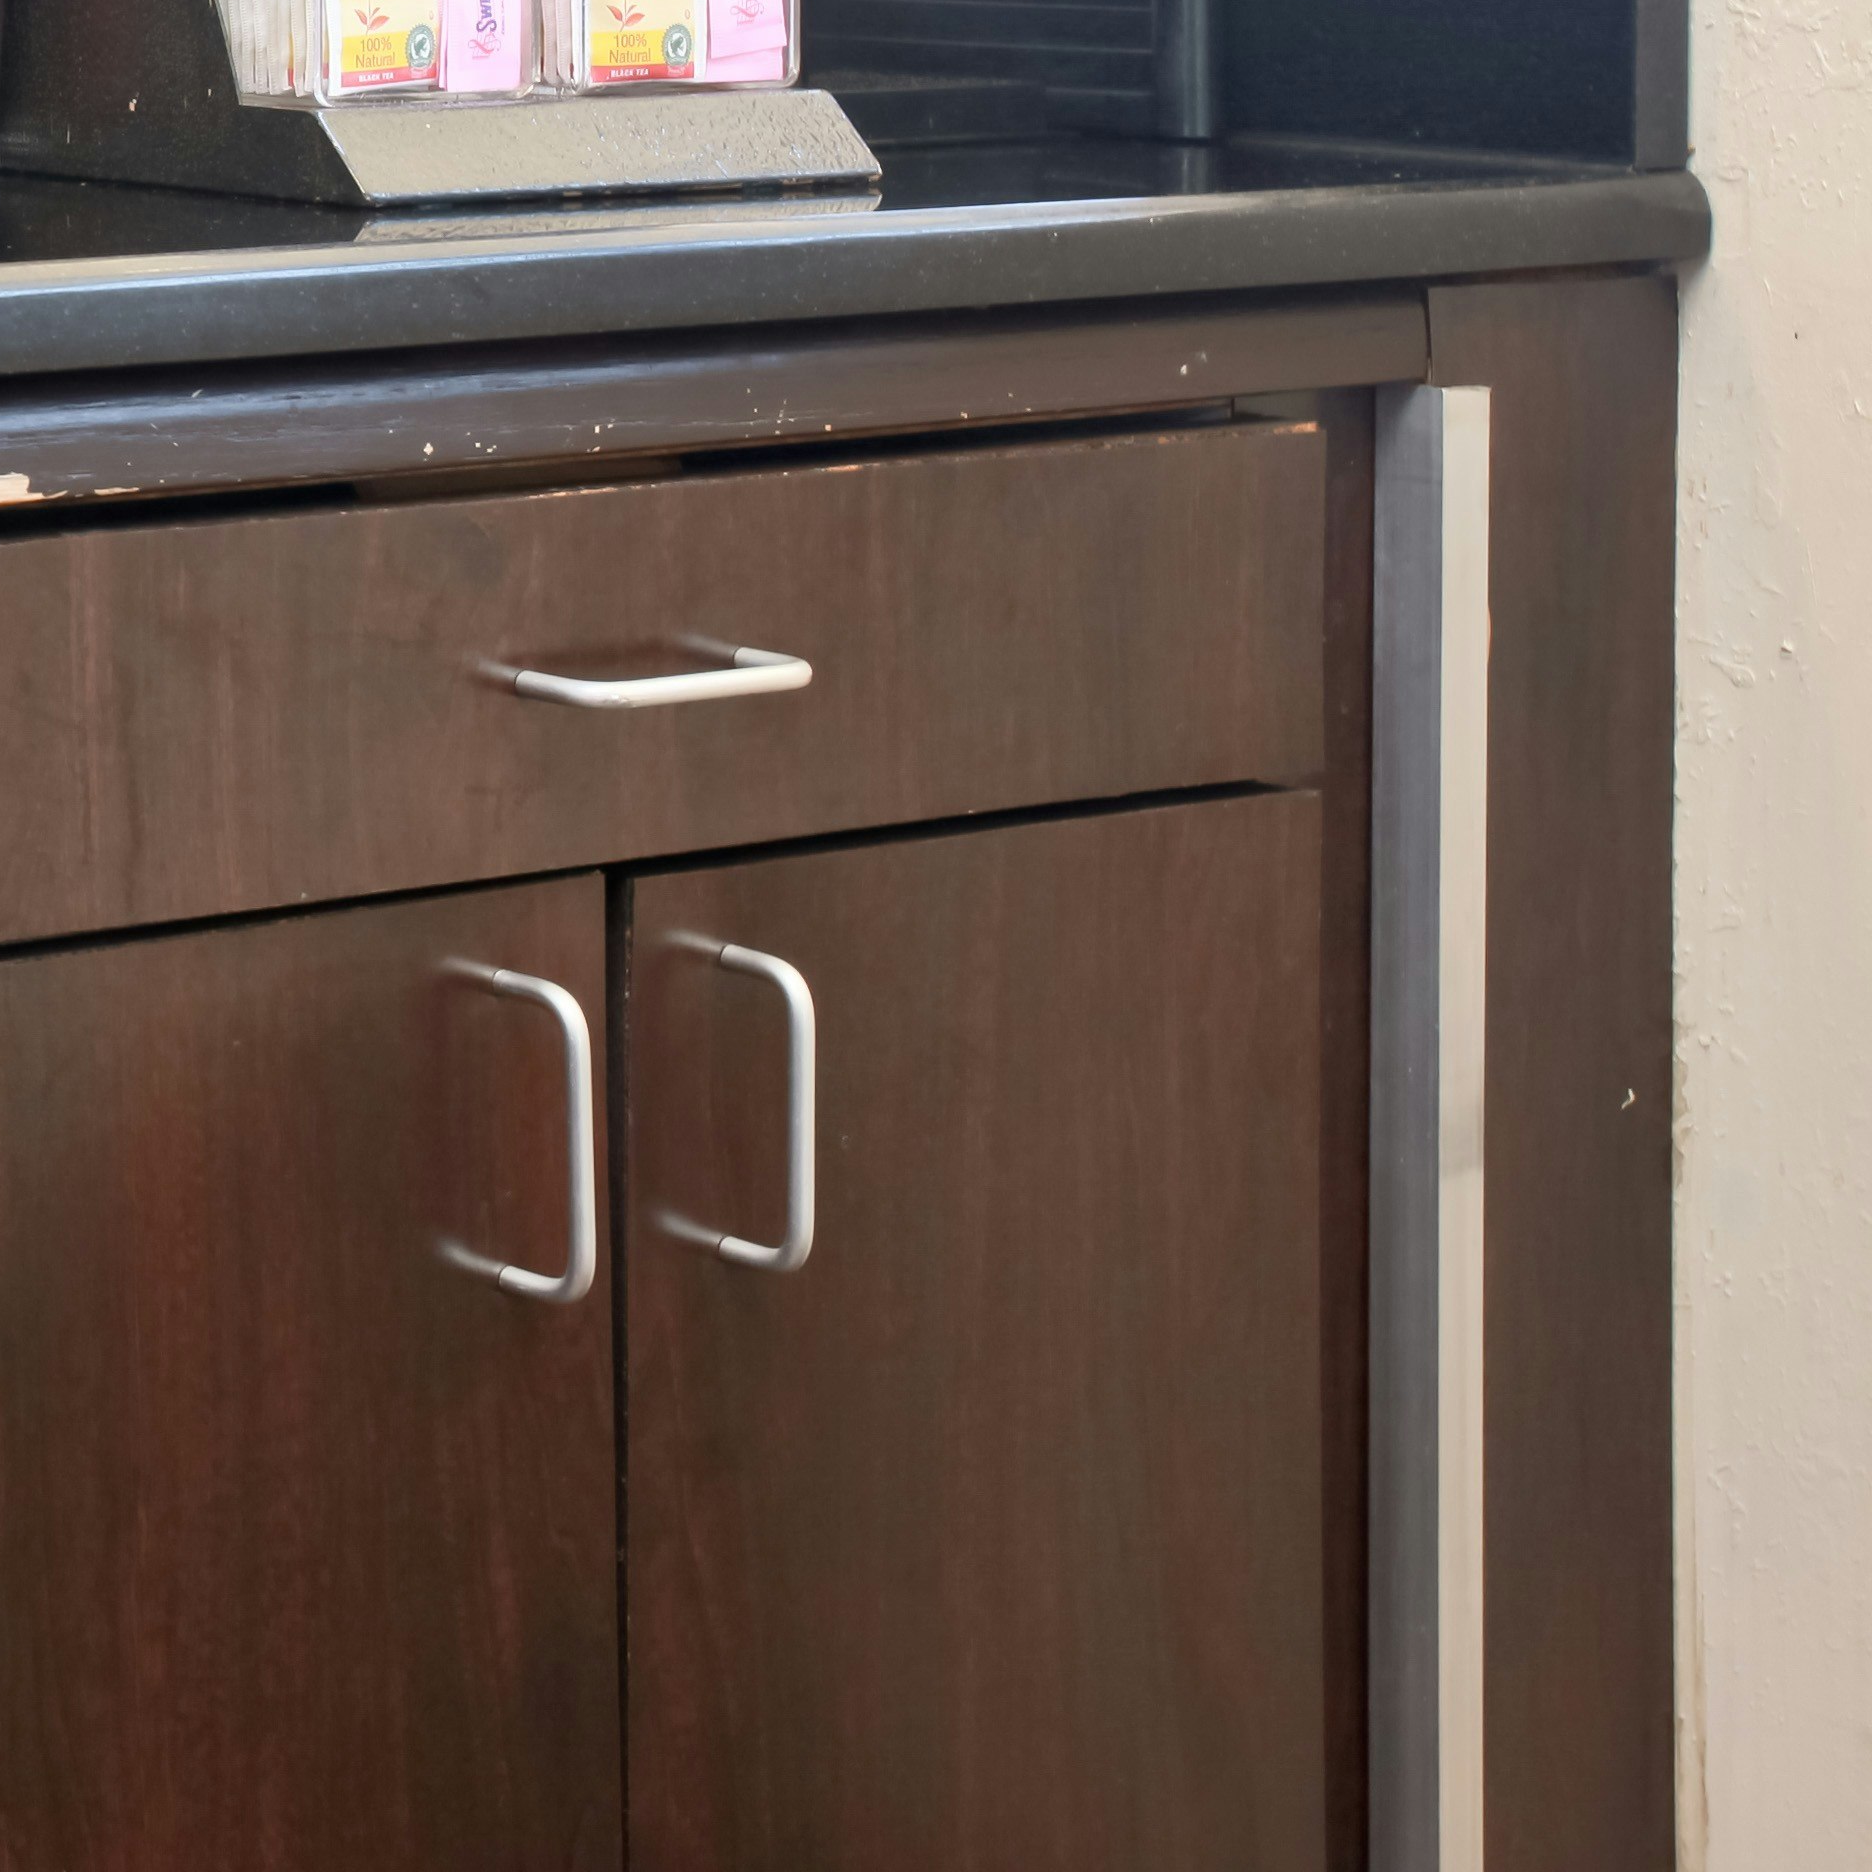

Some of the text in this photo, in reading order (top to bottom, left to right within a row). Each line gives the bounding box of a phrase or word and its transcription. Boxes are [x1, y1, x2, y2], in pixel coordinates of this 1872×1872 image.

[360, 35, 392, 53] 100%
[613, 32, 647, 48] 100%
[355, 51, 396, 69] Natural
[609, 47, 651, 64] Natural
[610, 68, 649, 78] BLACK TEA
